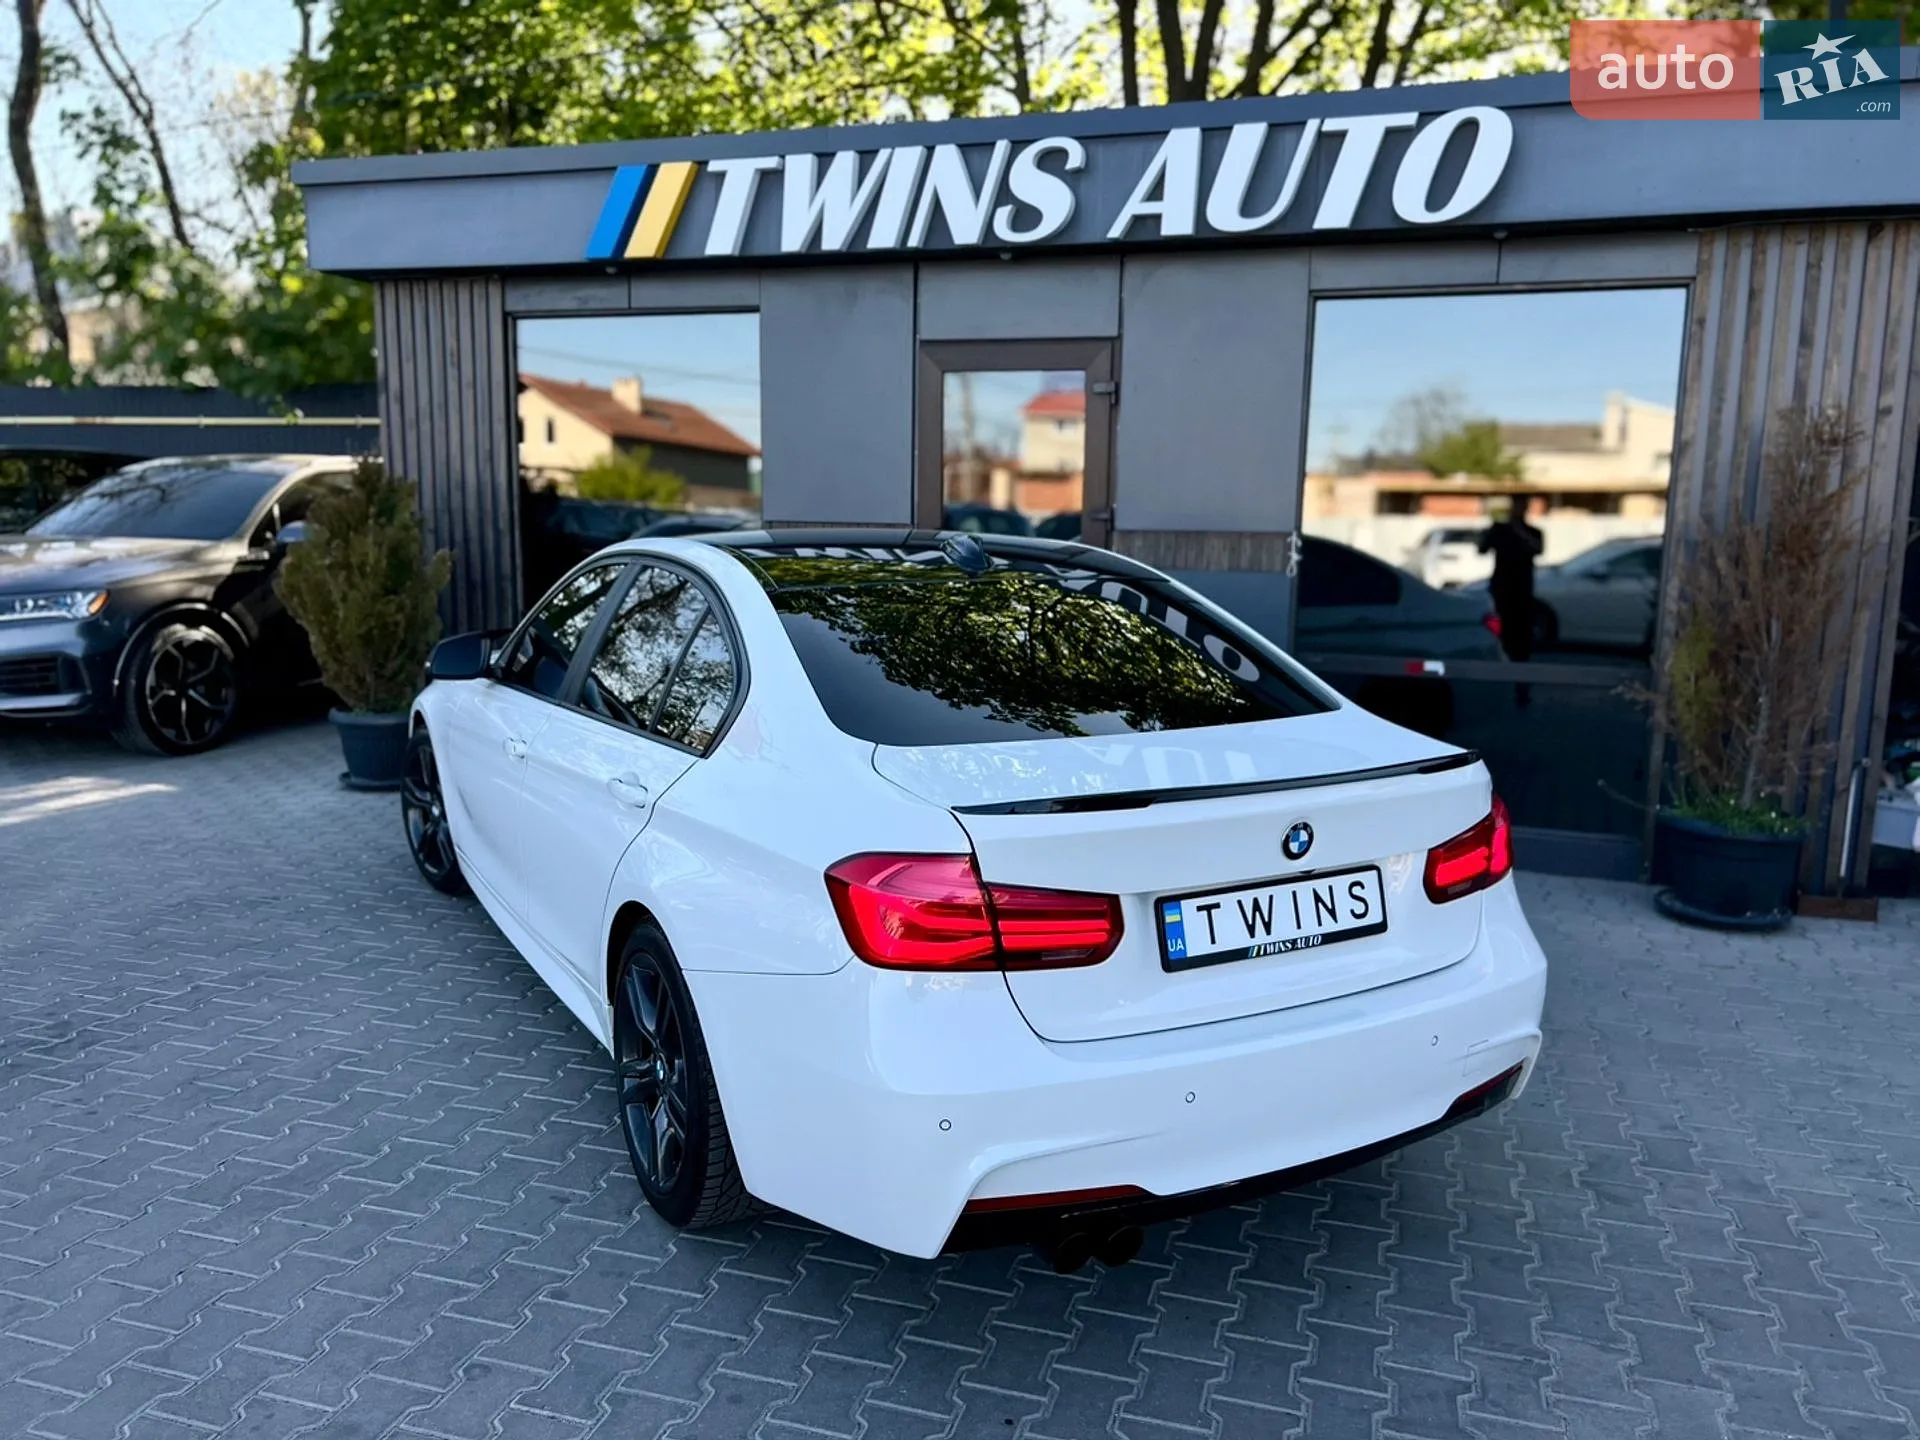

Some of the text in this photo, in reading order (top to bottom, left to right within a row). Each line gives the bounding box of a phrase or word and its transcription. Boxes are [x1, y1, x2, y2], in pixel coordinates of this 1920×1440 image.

[704, 106, 1513, 257] TWINS AUTO
[1196, 880, 1369, 945] TWINS
[1167, 938, 1184, 952] UA
[1259, 935, 1322, 956] TWINS AUTO
